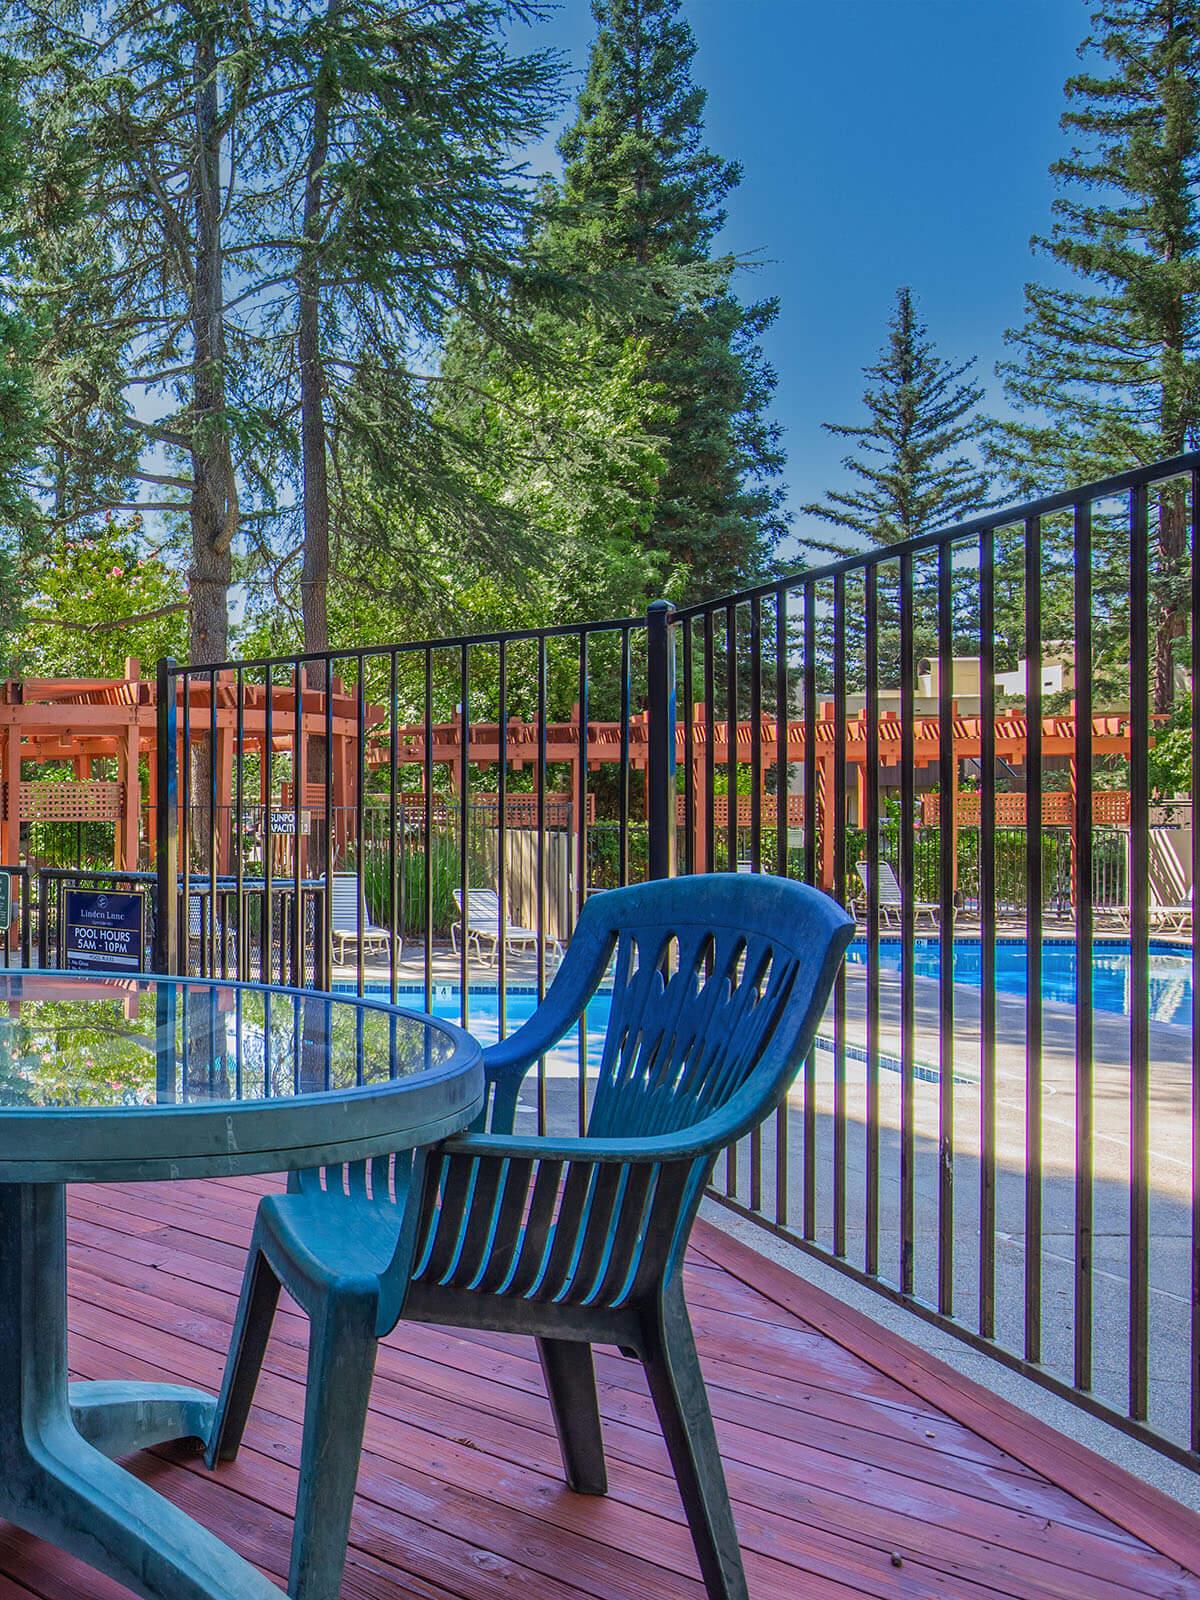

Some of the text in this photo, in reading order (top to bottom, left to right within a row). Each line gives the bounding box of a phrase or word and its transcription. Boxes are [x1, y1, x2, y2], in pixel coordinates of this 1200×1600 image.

[81, 909, 125, 920] Linden Lane
[74, 927, 130, 942] POOL HOURS
[77, 939, 97, 950] 5AM
[105, 941, 128, 953] 10PM
